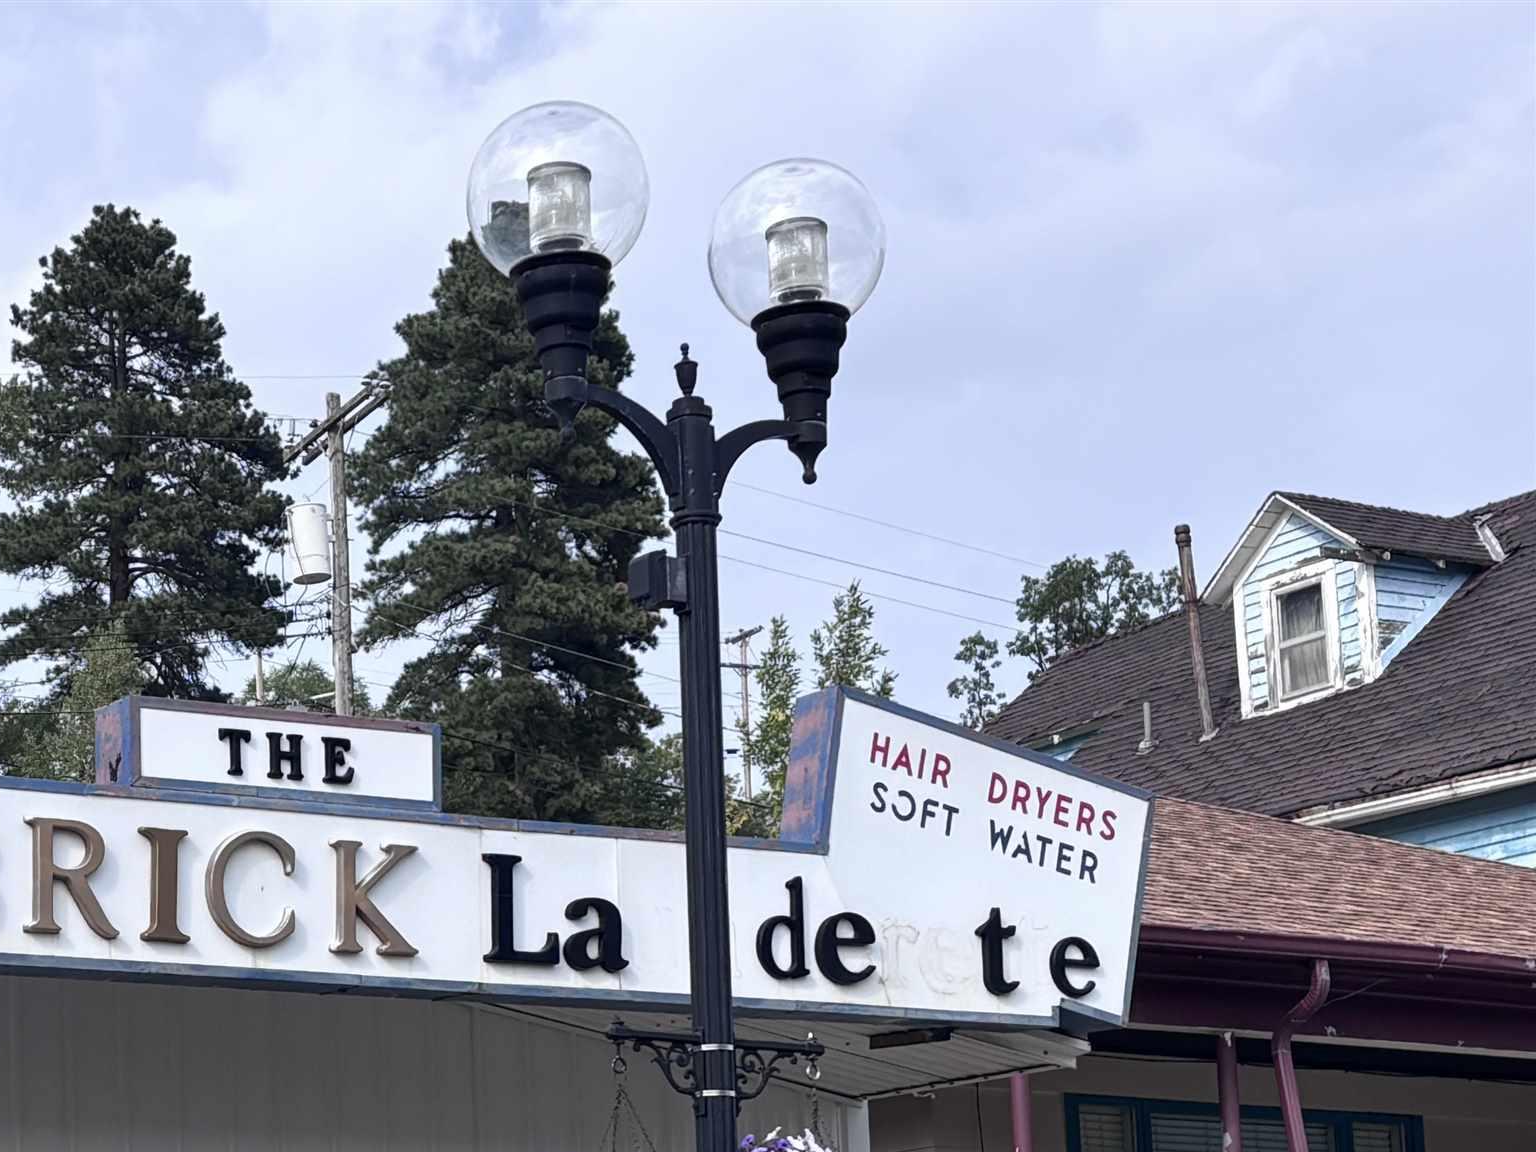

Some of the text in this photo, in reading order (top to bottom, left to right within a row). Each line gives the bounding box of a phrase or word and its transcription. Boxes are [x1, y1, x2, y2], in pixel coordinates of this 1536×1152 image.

[218, 727, 355, 787] THE
[869, 732, 1119, 842] HAIR DRYERS
[869, 781, 1099, 884] SOFT WATER
